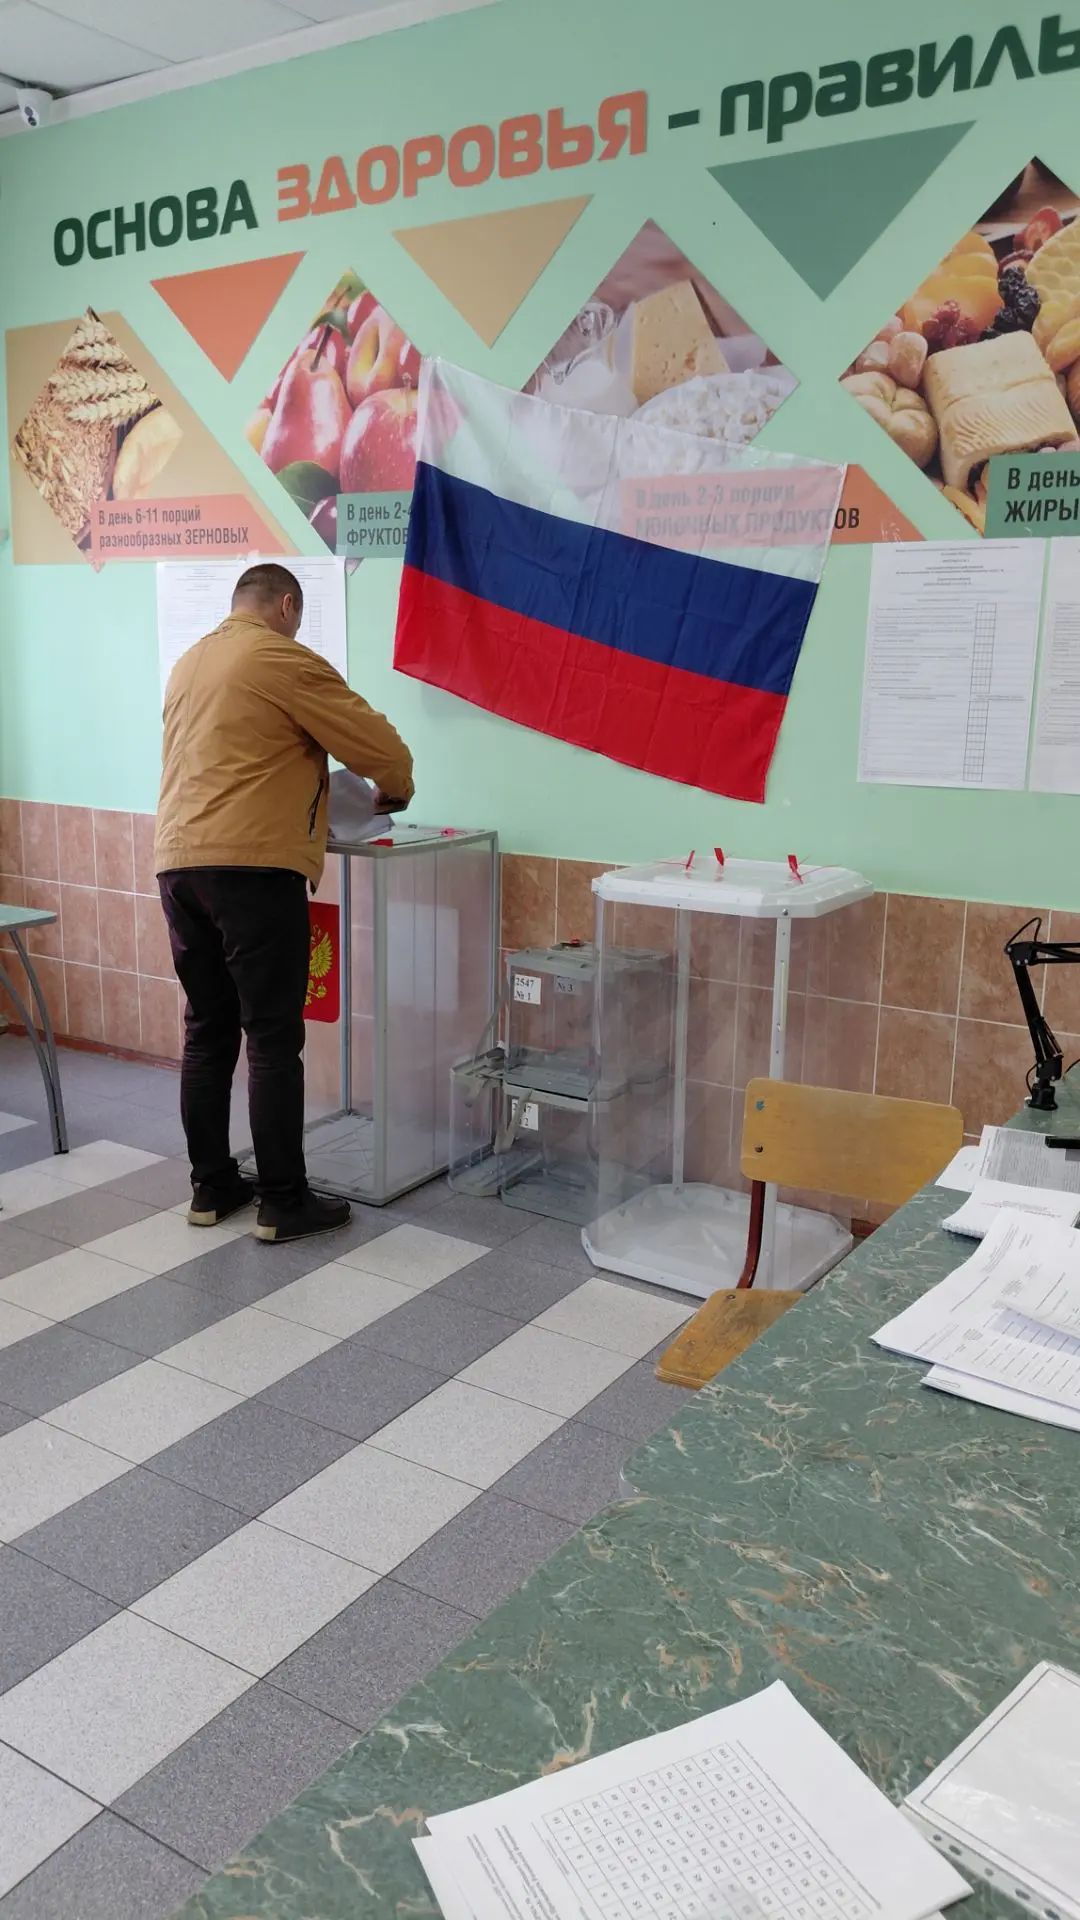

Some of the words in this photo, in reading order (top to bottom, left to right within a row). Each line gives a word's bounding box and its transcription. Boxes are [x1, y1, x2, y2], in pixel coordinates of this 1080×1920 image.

[53, 179, 259, 267] ОСНОВА
[277, 89, 648, 222] ЗДОРОВЬЯ
[719, 14, 1080, 144] правиль
[1007, 467, 1021, 490] В
[1027, 469, 1080, 492] день
[99, 509, 105, 525] В
[108, 511, 133, 527] день
[136, 508, 158, 524] 6-11
[162, 505, 201, 526] порций
[347, 503, 355, 521] В
[359, 505, 390, 523] день
[1004, 497, 1080, 523] ЖИРЫ
[99, 530, 182, 550] разнообразных
[185, 526, 249, 545] ЗЕРНОВЫХ
[515, 977, 534, 988] 2547
